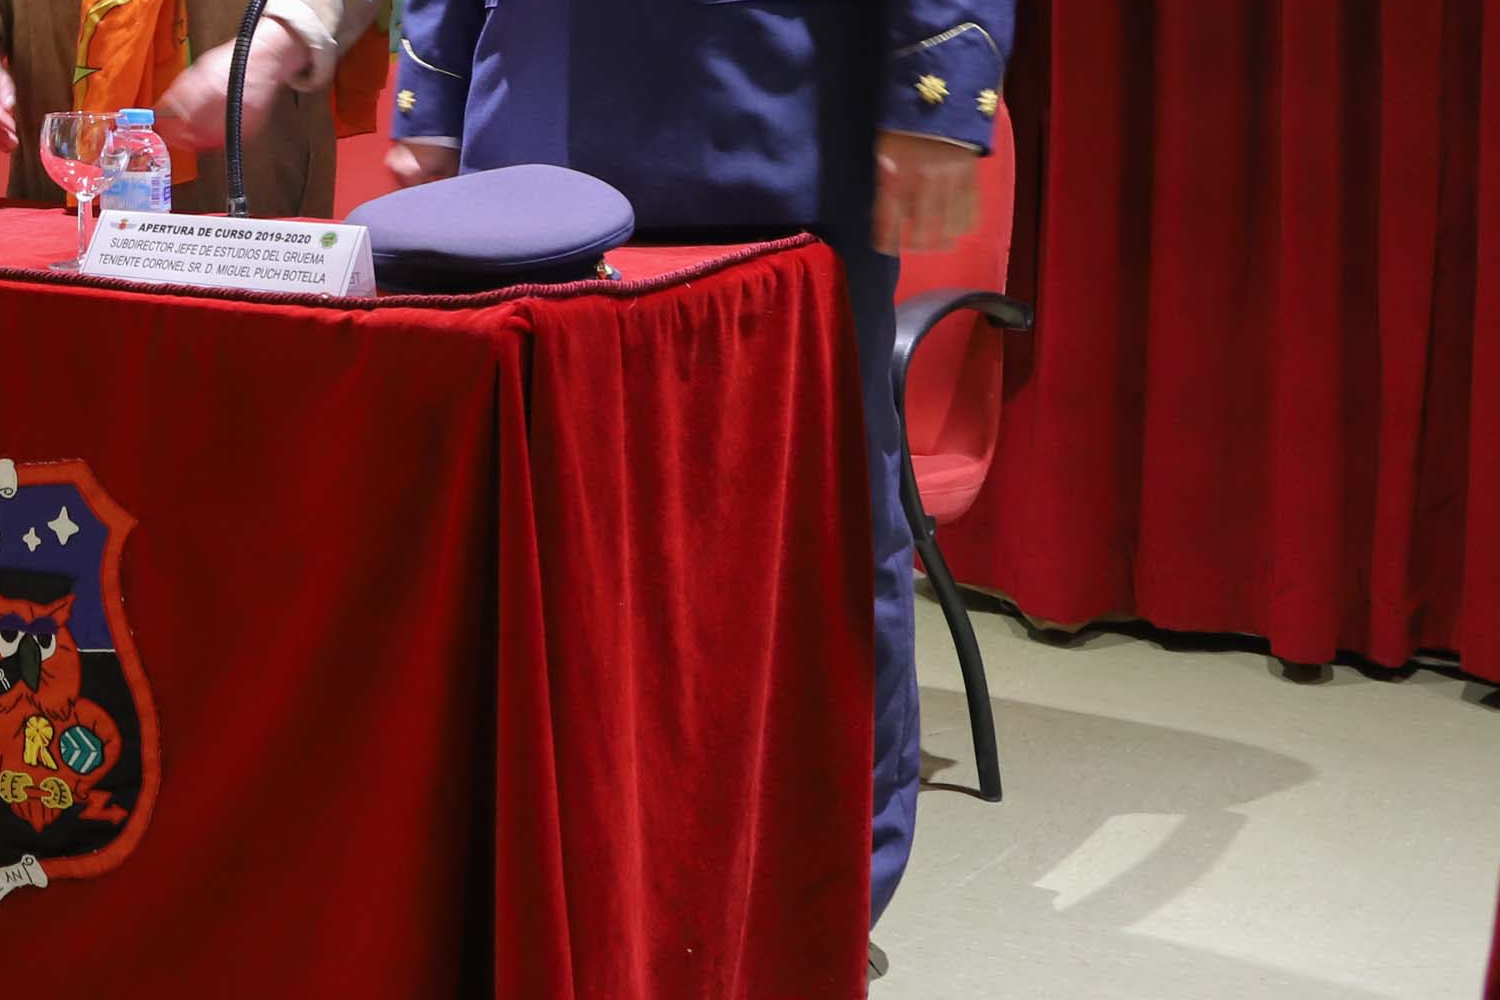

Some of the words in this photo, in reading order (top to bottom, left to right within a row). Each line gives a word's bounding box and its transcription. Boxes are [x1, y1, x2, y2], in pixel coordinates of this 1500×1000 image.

[138, 223, 195, 236] APERTURA
[197, 227, 212, 238] DE
[214, 228, 253, 240] CURSO
[255, 231, 312, 244] 2019-2020
[110, 237, 174, 253] SUBDIRECTOR
[174, 243, 198, 255] JEFE
[198, 245, 212, 257] DE
[213, 246, 260, 260] ESTUDIOS
[262, 249, 280, 262] DEL
[283, 251, 325, 265] GRUEMA
[99, 253, 142, 268] TENIENTE
[142, 257, 185, 272] CORONEL
[215, 264, 251, 278] MIGUEL
[253, 267, 281, 281] PUCH
[282, 270, 326, 284] BOTELLA
